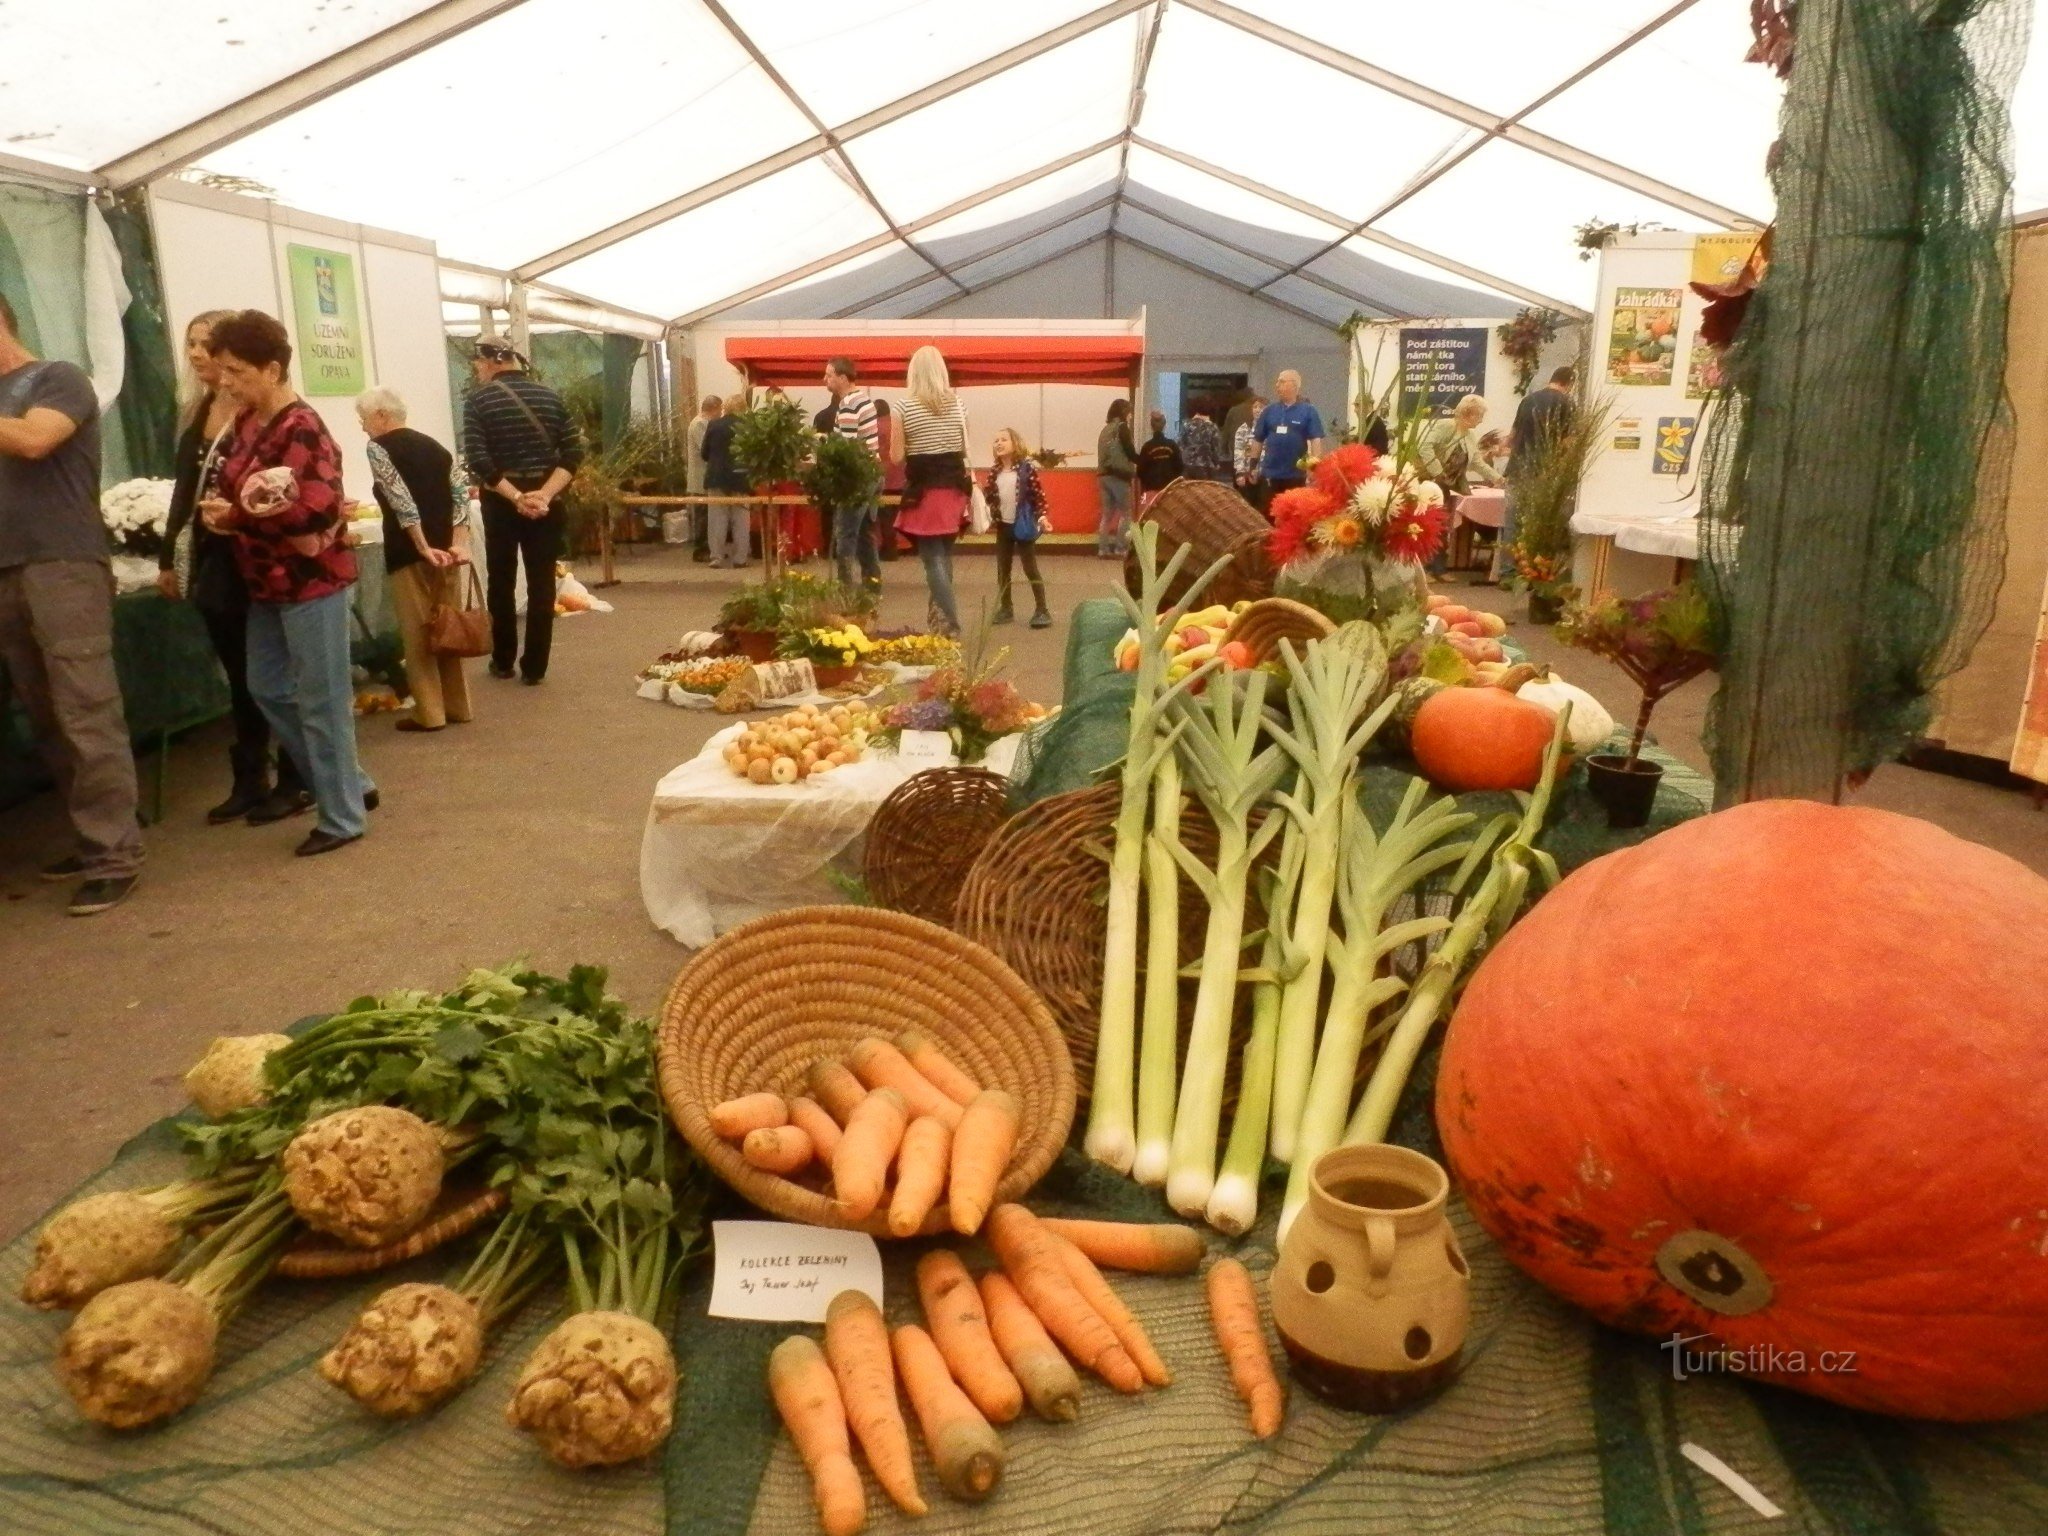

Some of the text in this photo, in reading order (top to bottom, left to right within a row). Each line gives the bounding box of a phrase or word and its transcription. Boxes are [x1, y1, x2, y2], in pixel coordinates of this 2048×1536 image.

[1406, 338, 1470, 349] Pod záštitou
[1405, 350, 1455, 360] námětka
[1405, 361, 1456, 372] primtora
[1437, 382, 1477, 394] Ostravy
[740, 1256, 790, 1268] KOLEKCE
